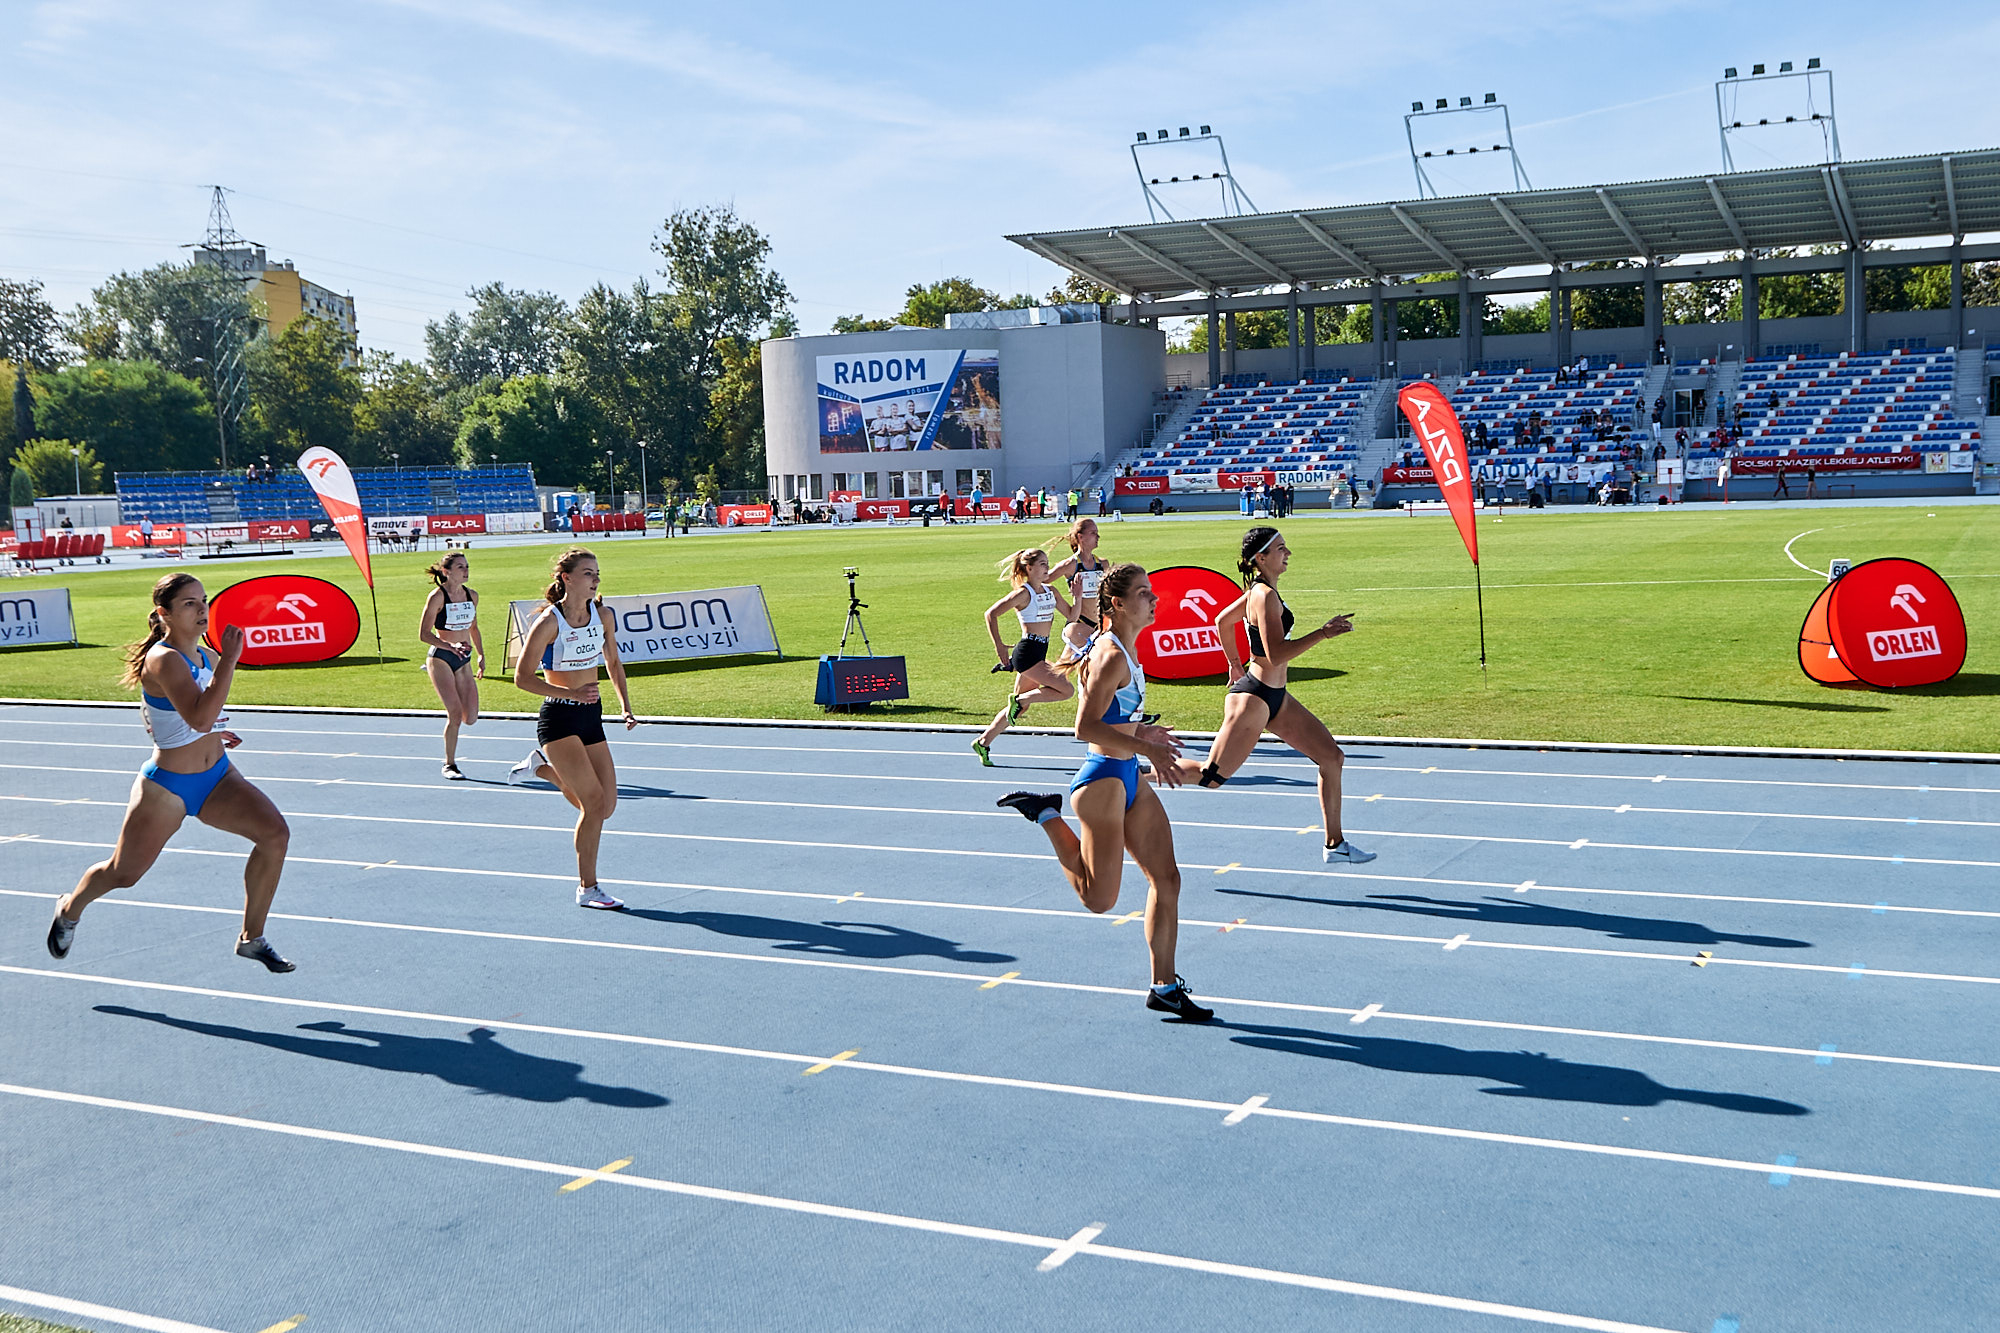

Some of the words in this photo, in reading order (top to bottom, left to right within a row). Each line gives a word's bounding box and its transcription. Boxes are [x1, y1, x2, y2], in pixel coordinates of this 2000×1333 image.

[834, 357, 926, 385] RADOM
[822, 389, 852, 402] kultura
[906, 385, 930, 395] sport
[925, 413, 940, 440] rozwój
[1737, 460, 1774, 468] POLSKI
[1824, 457, 1864, 466] LEKKIEJ
[1866, 455, 1914, 465] ATLETYKI
[1279, 472, 1323, 483] RADOM
[911, 504, 924, 512] 4F
[925, 504, 939, 512] 4F
[311, 523, 328, 533] 4F
[372, 520, 408, 530] 4MOVE
[432, 519, 480, 529] PZLA.PL
[213, 529, 242, 537] ORLEN
[1833, 565, 1849, 577] 60
[250, 625, 320, 644] ORLEN
[587, 627, 598, 637] 11
[646, 626, 739, 653] precyzji
[1159, 630, 1222, 653] ORLEN
[1873, 630, 1936, 656] ORLEN
[576, 644, 596, 654] OŻGA
